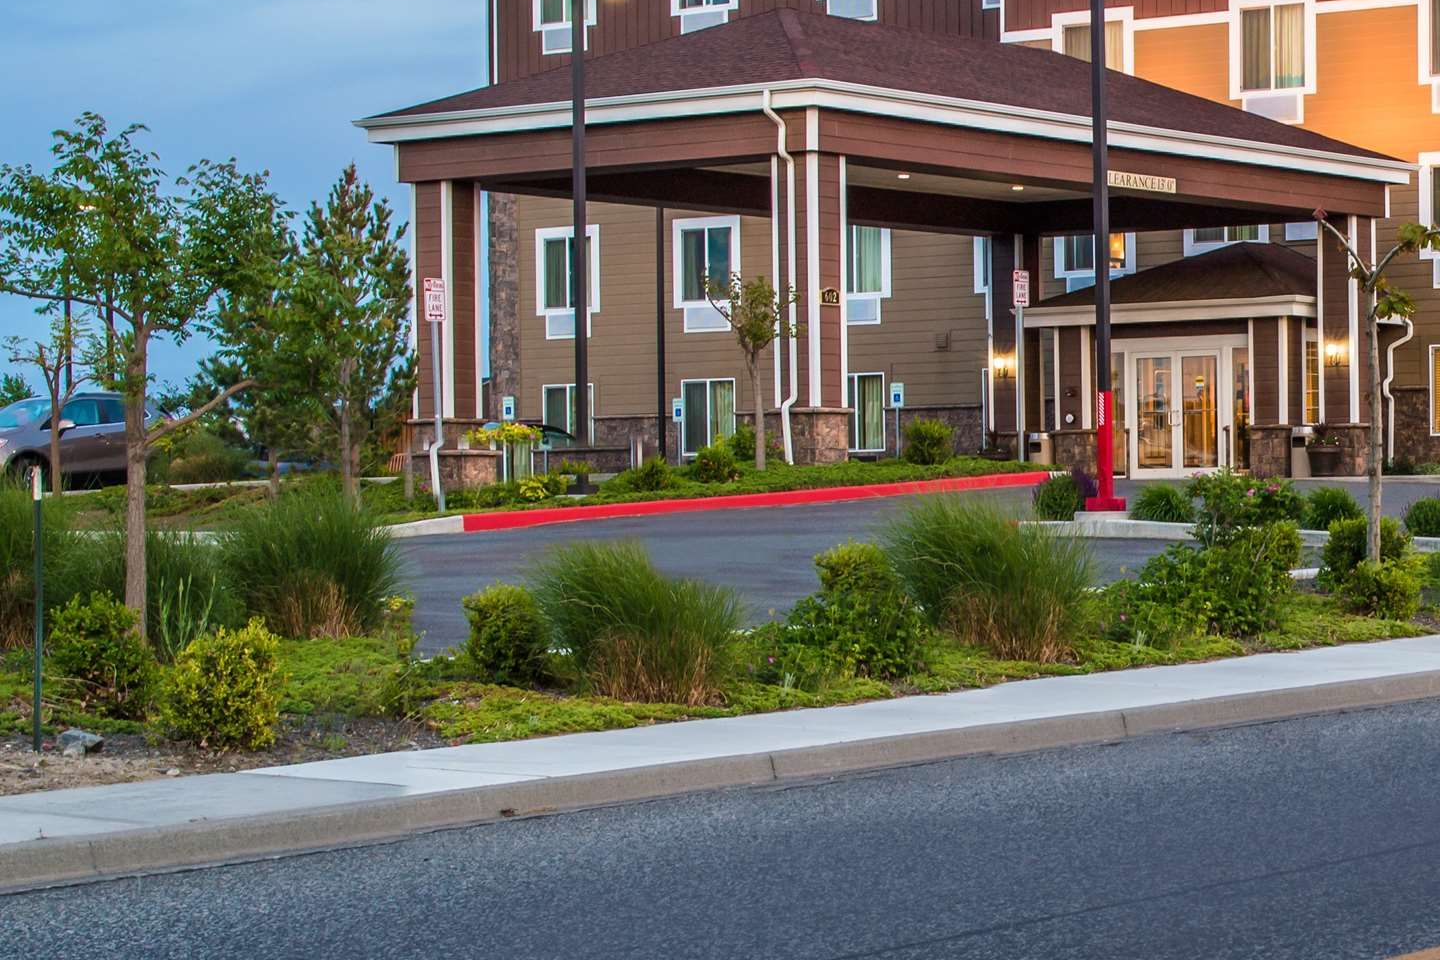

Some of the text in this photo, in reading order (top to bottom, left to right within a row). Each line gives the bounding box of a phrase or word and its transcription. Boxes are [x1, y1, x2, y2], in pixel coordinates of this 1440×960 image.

[1108, 172, 1156, 190] LEARANCE
[428, 293, 442, 303] FIRE
[428, 303, 443, 313] LANE
